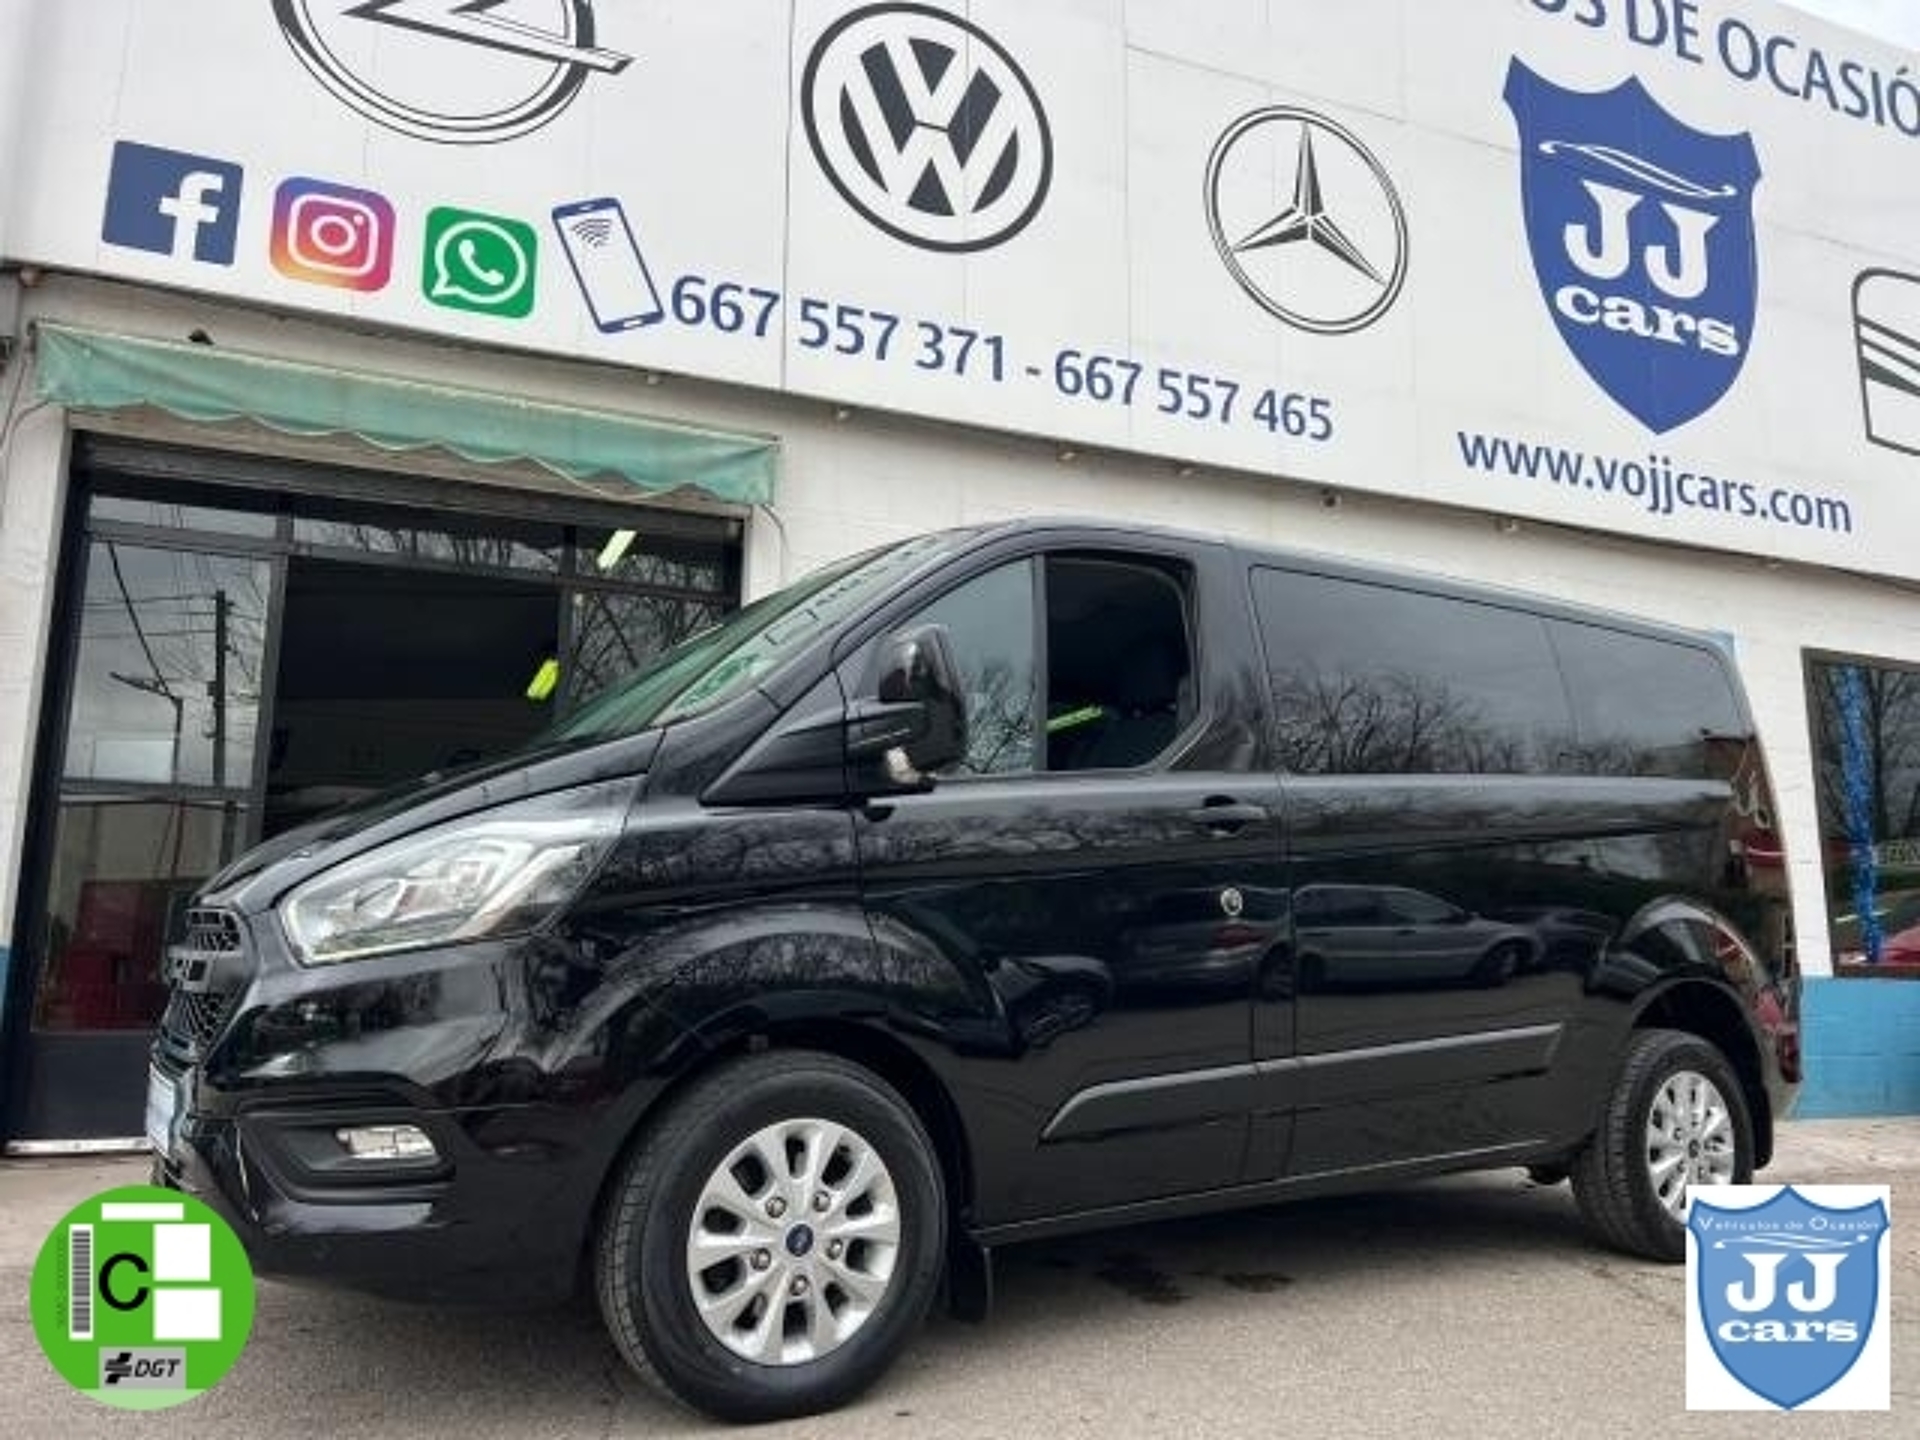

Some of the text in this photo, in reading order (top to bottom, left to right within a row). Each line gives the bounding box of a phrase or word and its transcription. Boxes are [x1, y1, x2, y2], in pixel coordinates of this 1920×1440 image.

[1625, 0, 1703, 63] DE
[1564, 178, 1719, 299] JJ
[671, 275, 781, 337] 667
[799, 298, 899, 361] 557
[915, 320, 1003, 382] 371
[1055, 350, 1142, 405] 667
[1157, 368, 1240, 423] 557
[1252, 389, 1333, 441] 465
[1556, 286, 1739, 356] cars
[1457, 431, 1852, 533] www.vojjcars.com
